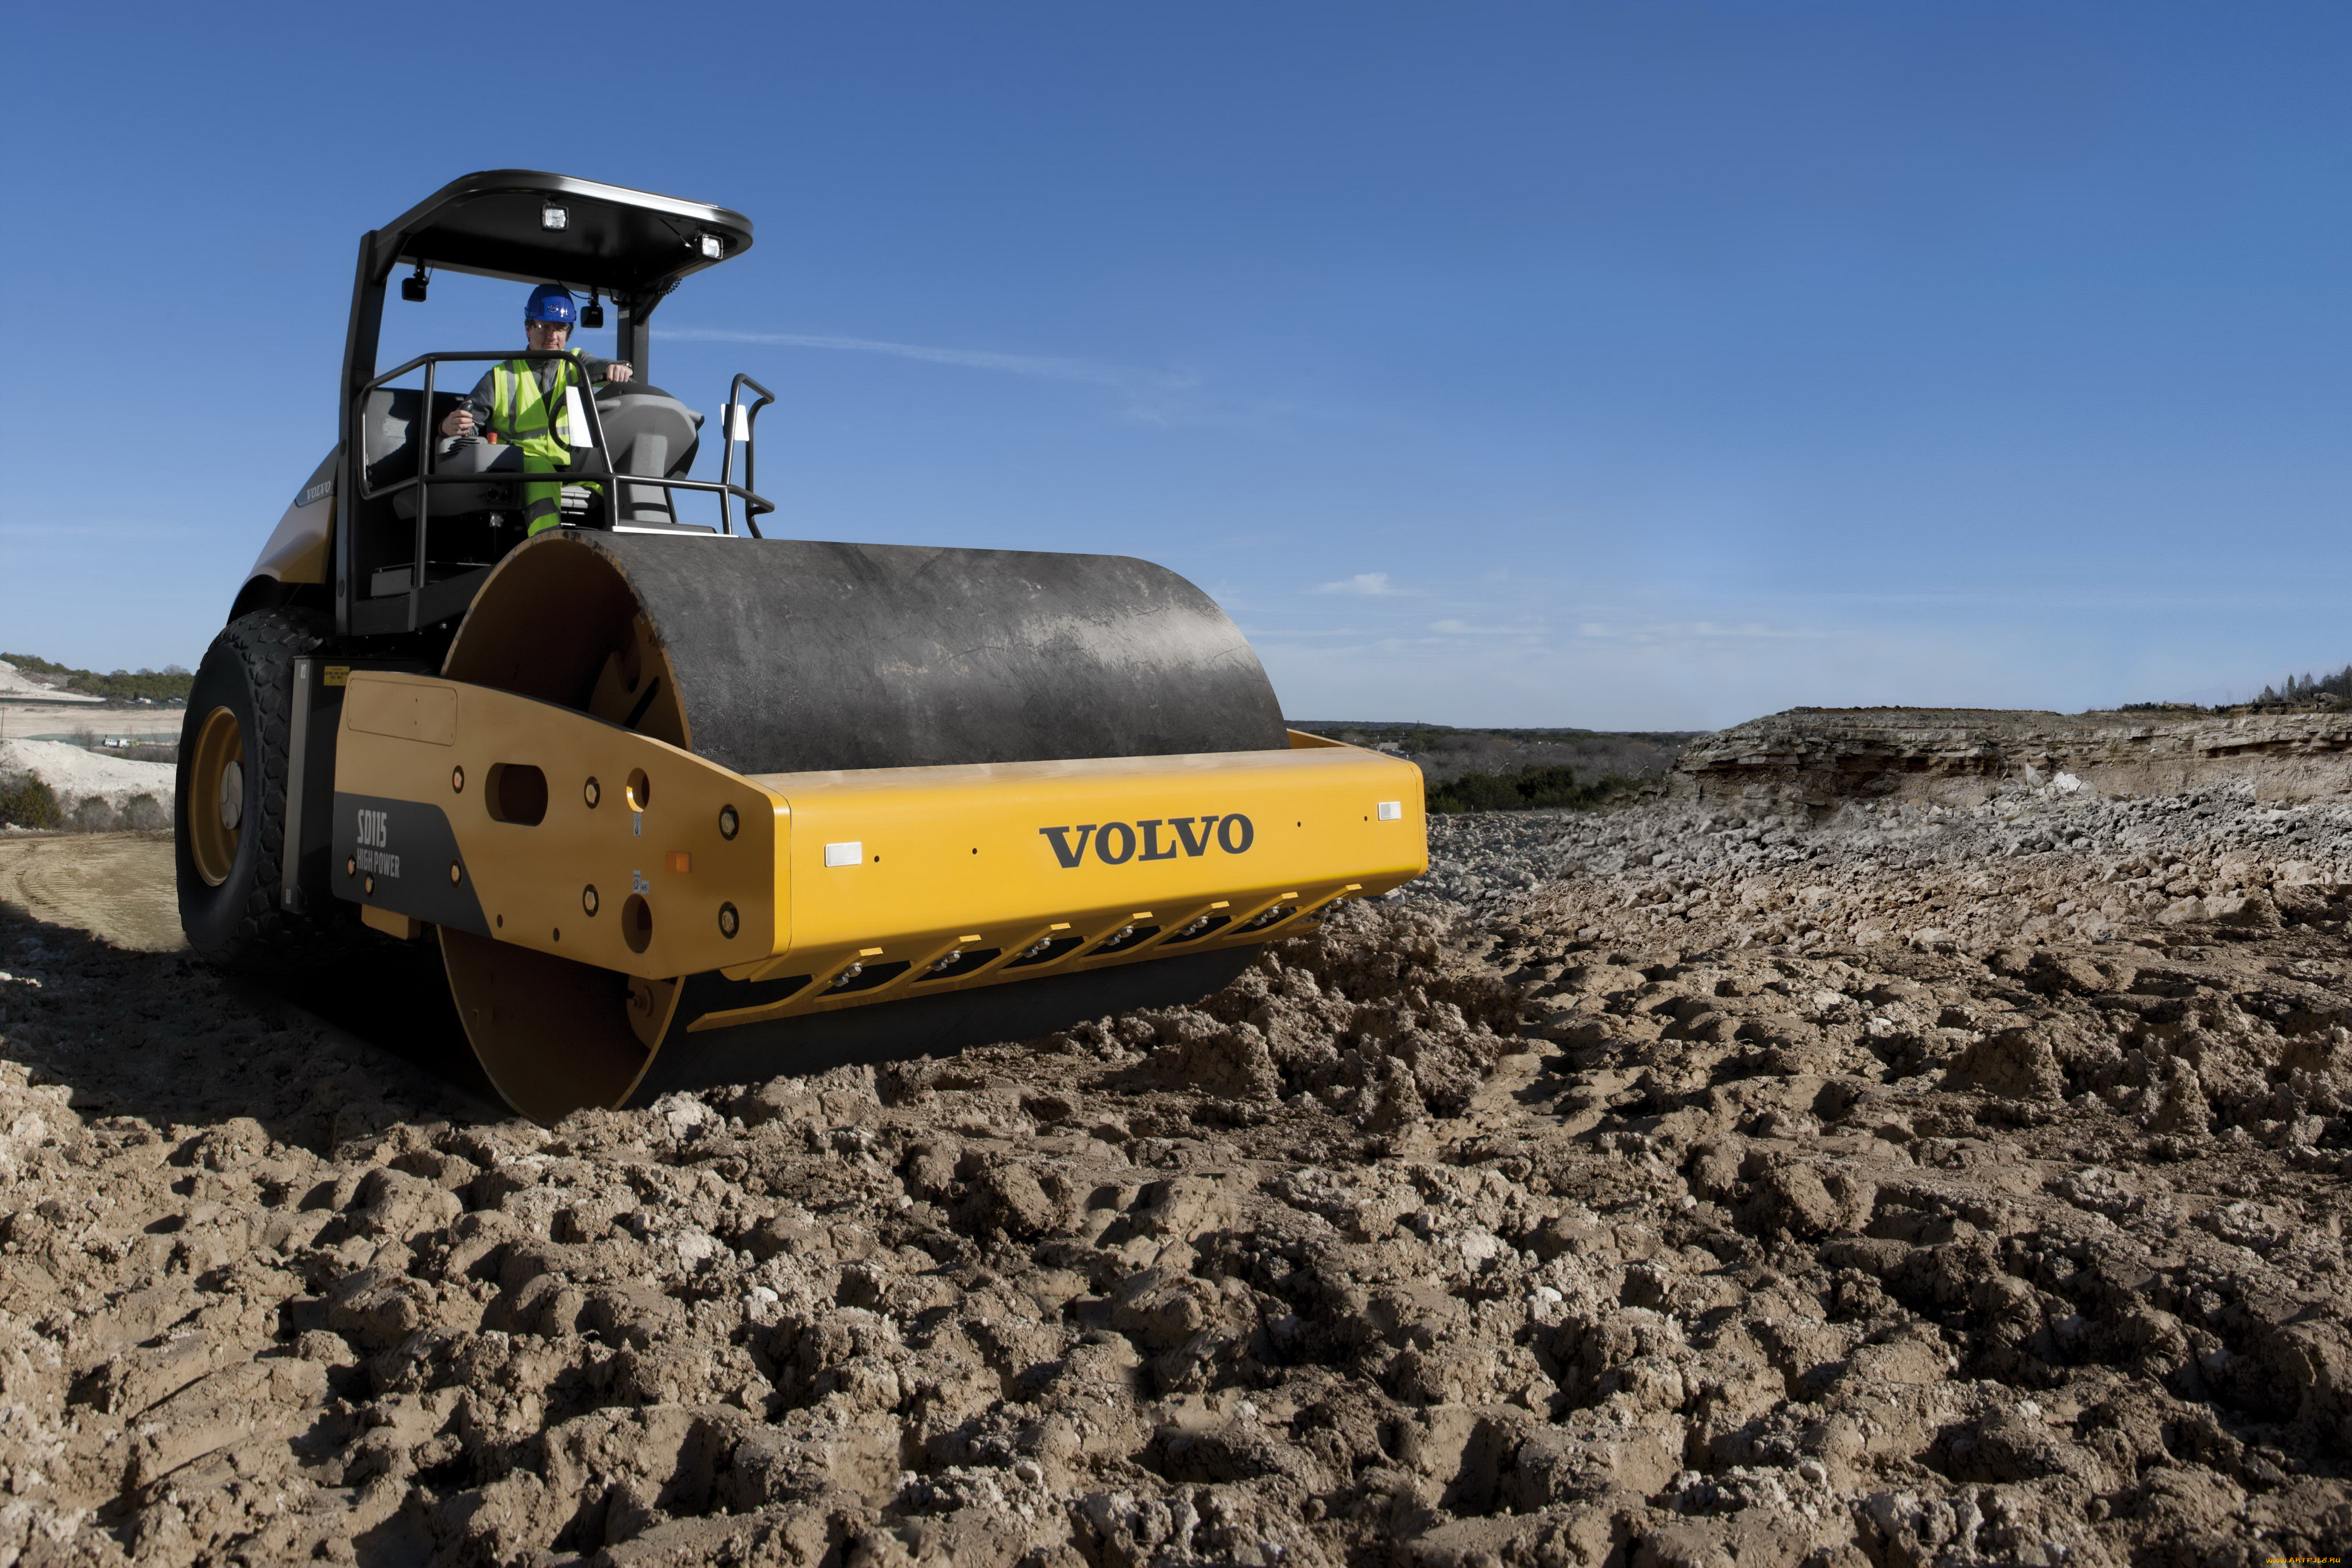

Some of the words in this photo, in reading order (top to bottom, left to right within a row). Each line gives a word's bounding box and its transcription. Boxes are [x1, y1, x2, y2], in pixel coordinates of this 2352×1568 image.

[307, 481, 331, 500] VOLVO
[357, 809, 387, 847] SD115
[1039, 813, 1254, 869] VOLVO
[357, 847, 373, 872] HIGH
[374, 851, 400, 878] POWER
